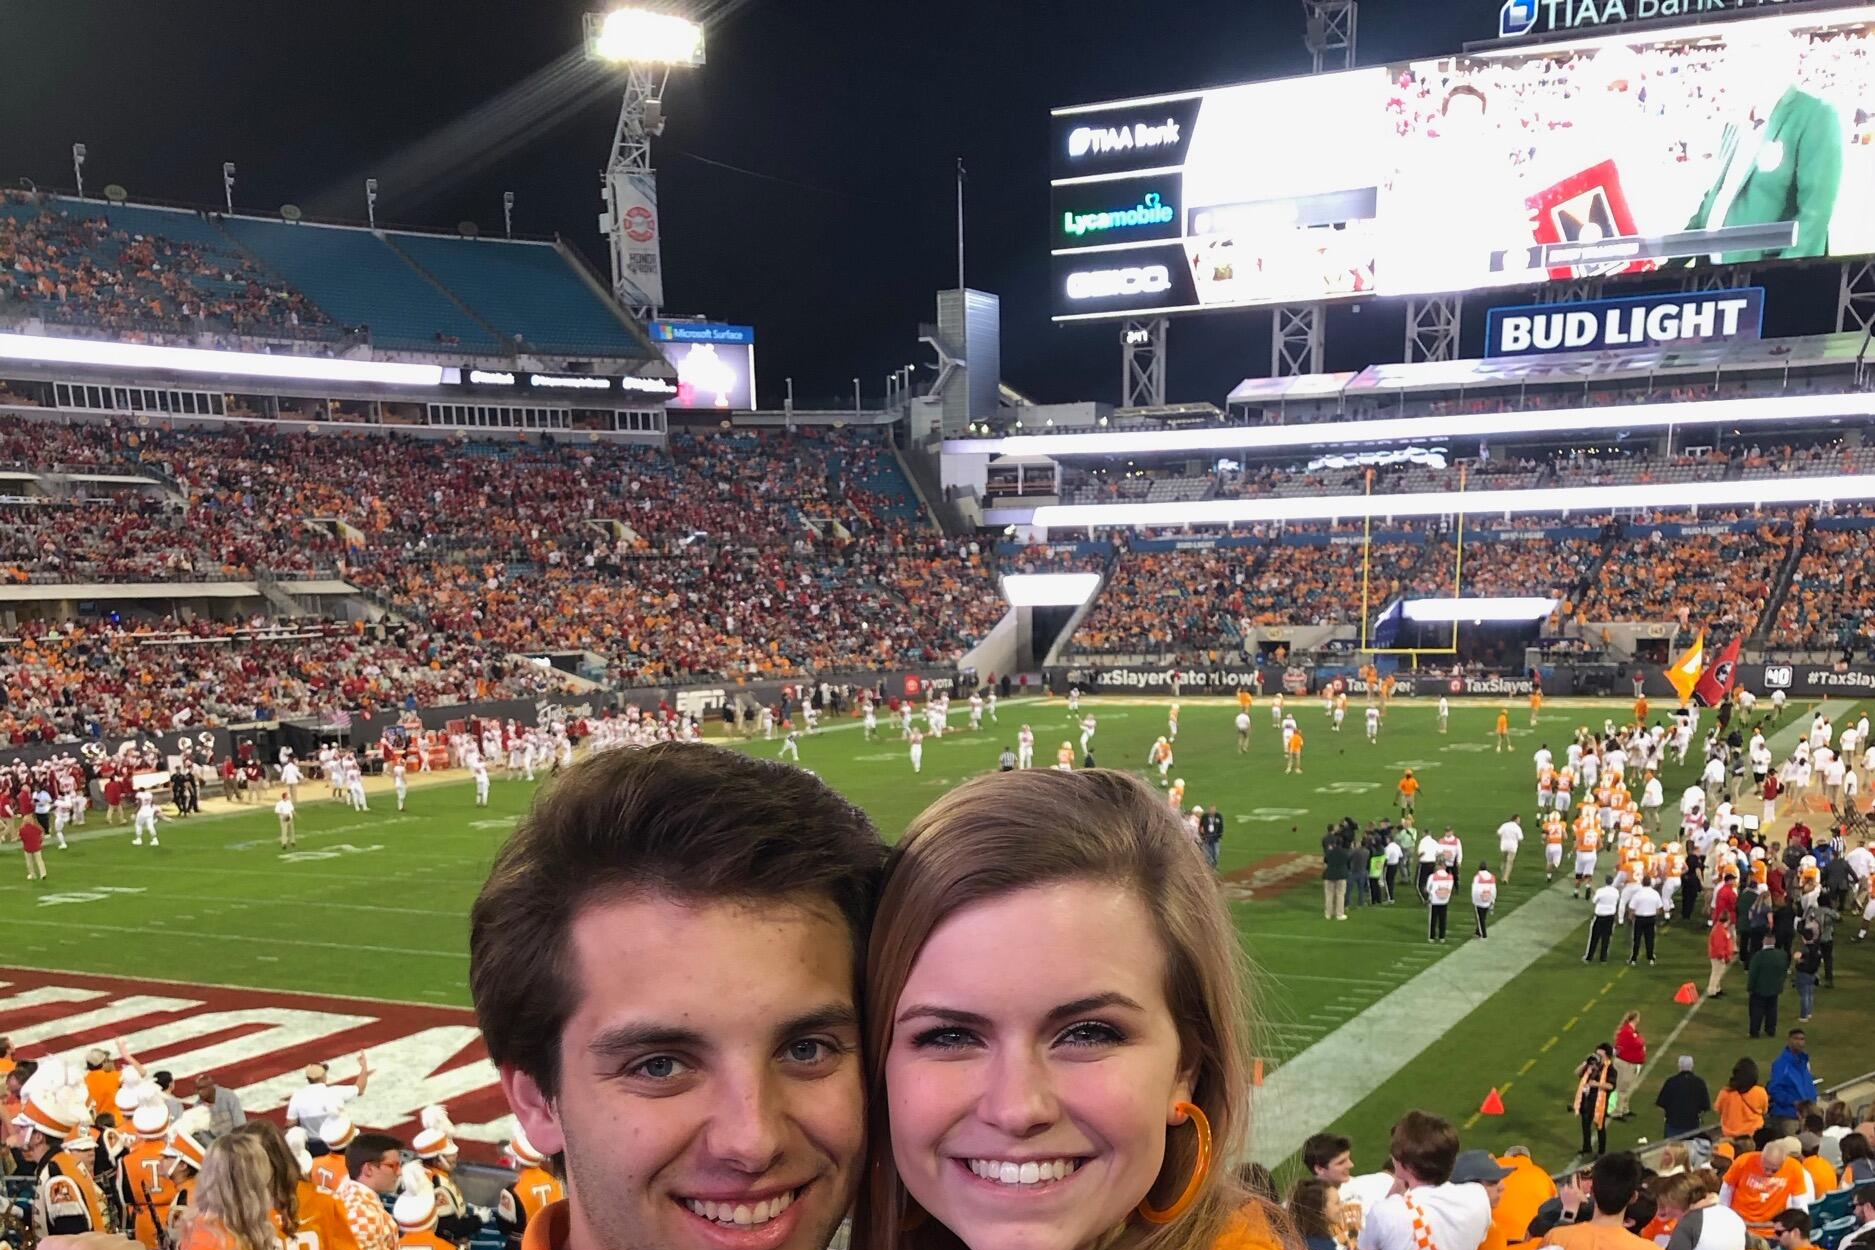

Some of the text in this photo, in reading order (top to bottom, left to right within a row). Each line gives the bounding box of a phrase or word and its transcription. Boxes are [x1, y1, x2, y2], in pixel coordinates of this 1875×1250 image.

[1135, 118, 1181, 148] Bank
[1064, 203, 1174, 235] Lycamobile
[673, 328, 744, 340] Microsoft Surface
[1501, 299, 1748, 352] BUD LIGHT
[142, 1159, 163, 1193] T
[316, 1167, 334, 1194] T
